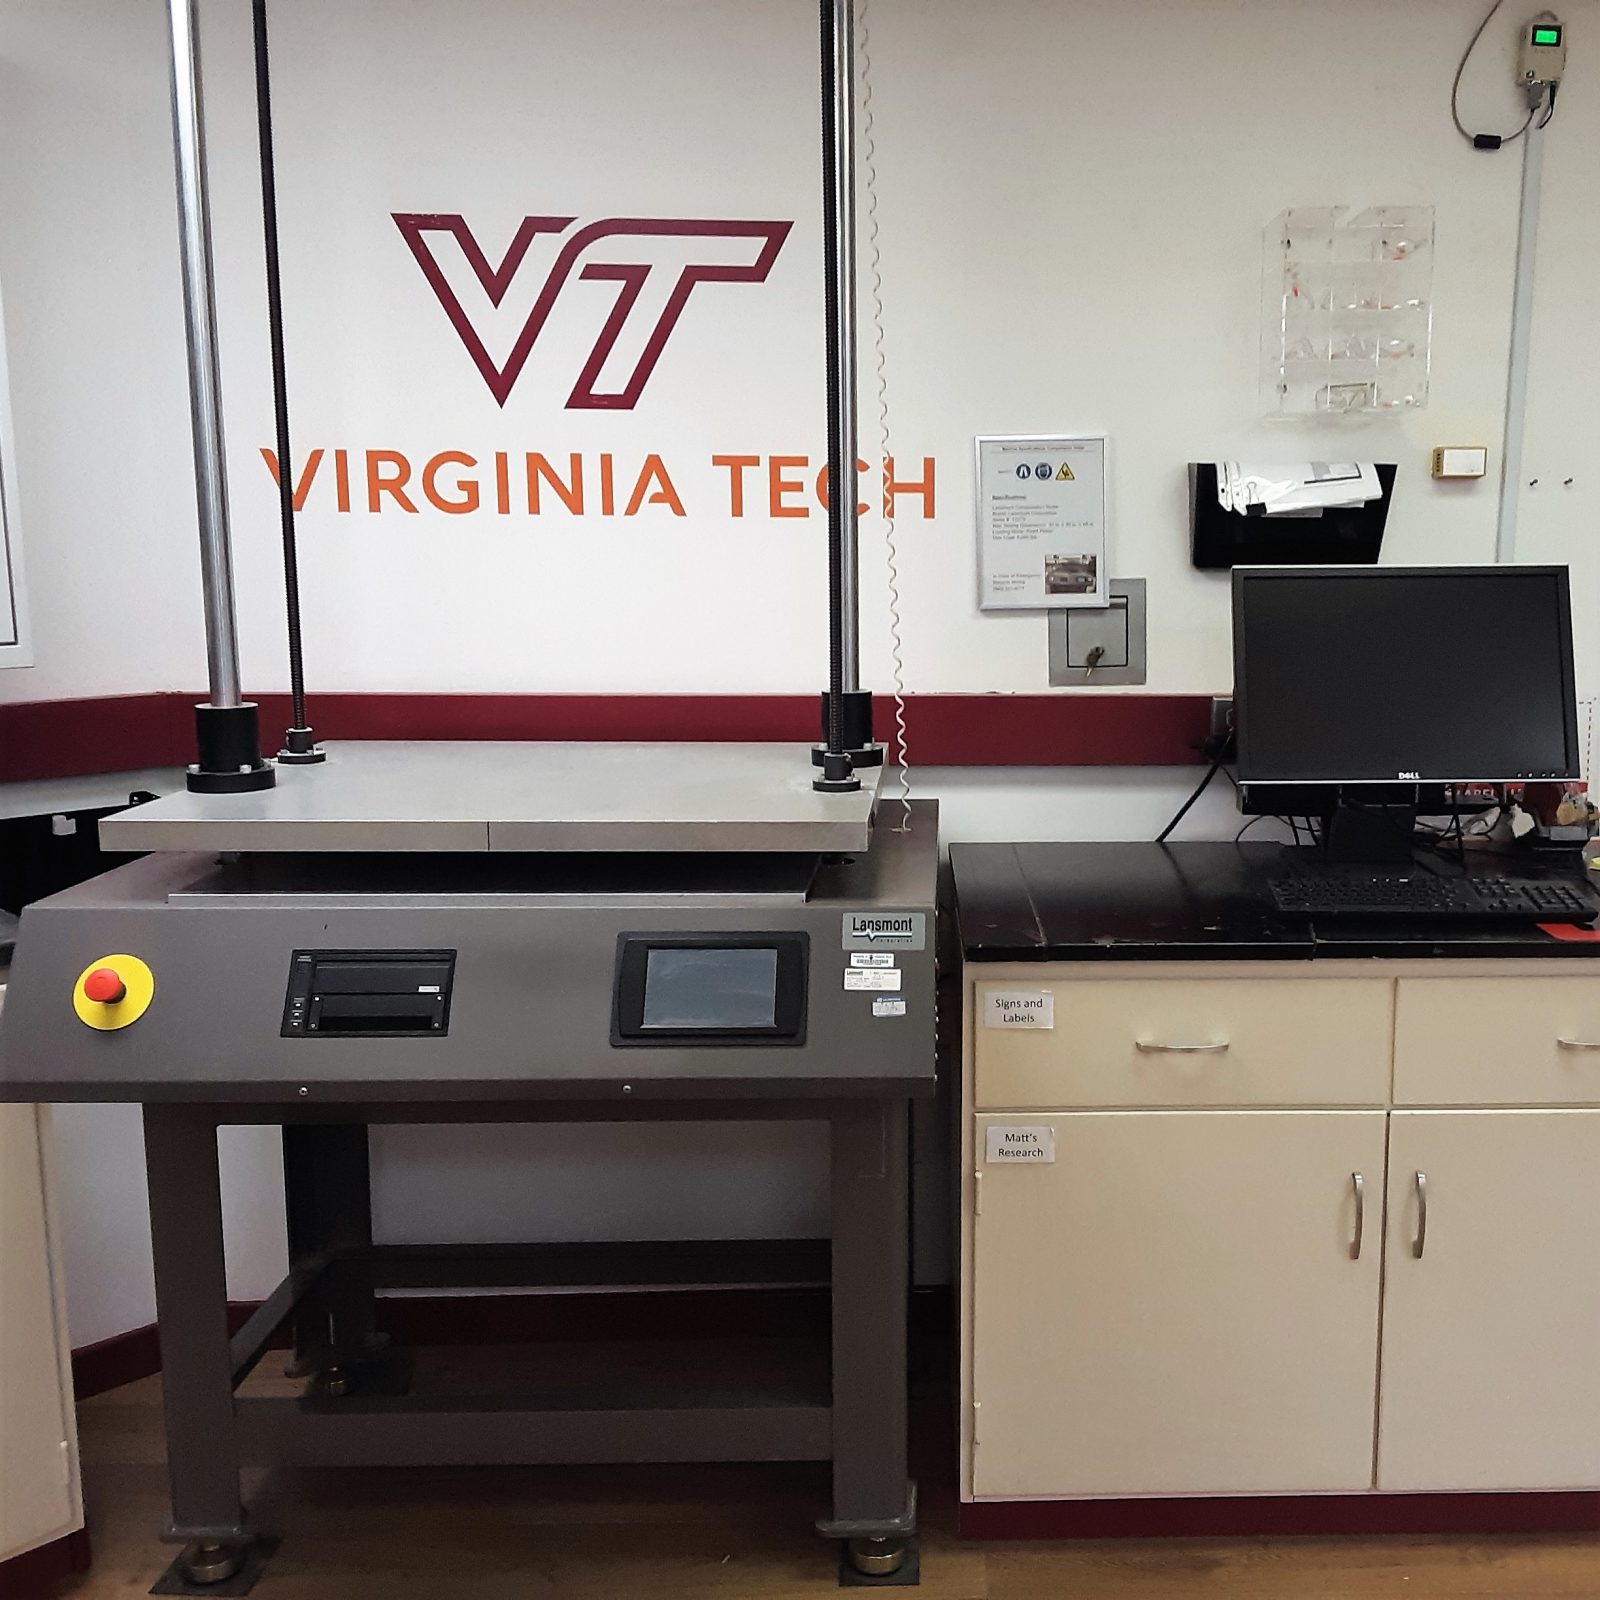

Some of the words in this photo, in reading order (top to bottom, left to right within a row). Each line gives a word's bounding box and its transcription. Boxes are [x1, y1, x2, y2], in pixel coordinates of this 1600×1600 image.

[259, 447, 688, 517] VIRGINIA
[1398, 772, 1420, 780] DELL
[852, 917, 912, 931] Lansmont
[995, 999, 1021, 1010] Signs
[1023, 999, 1043, 1008] and
[1003, 1014, 1035, 1023] Labels
[1005, 1133, 1038, 1143] Matt's
[998, 1148, 1043, 1158] Research
